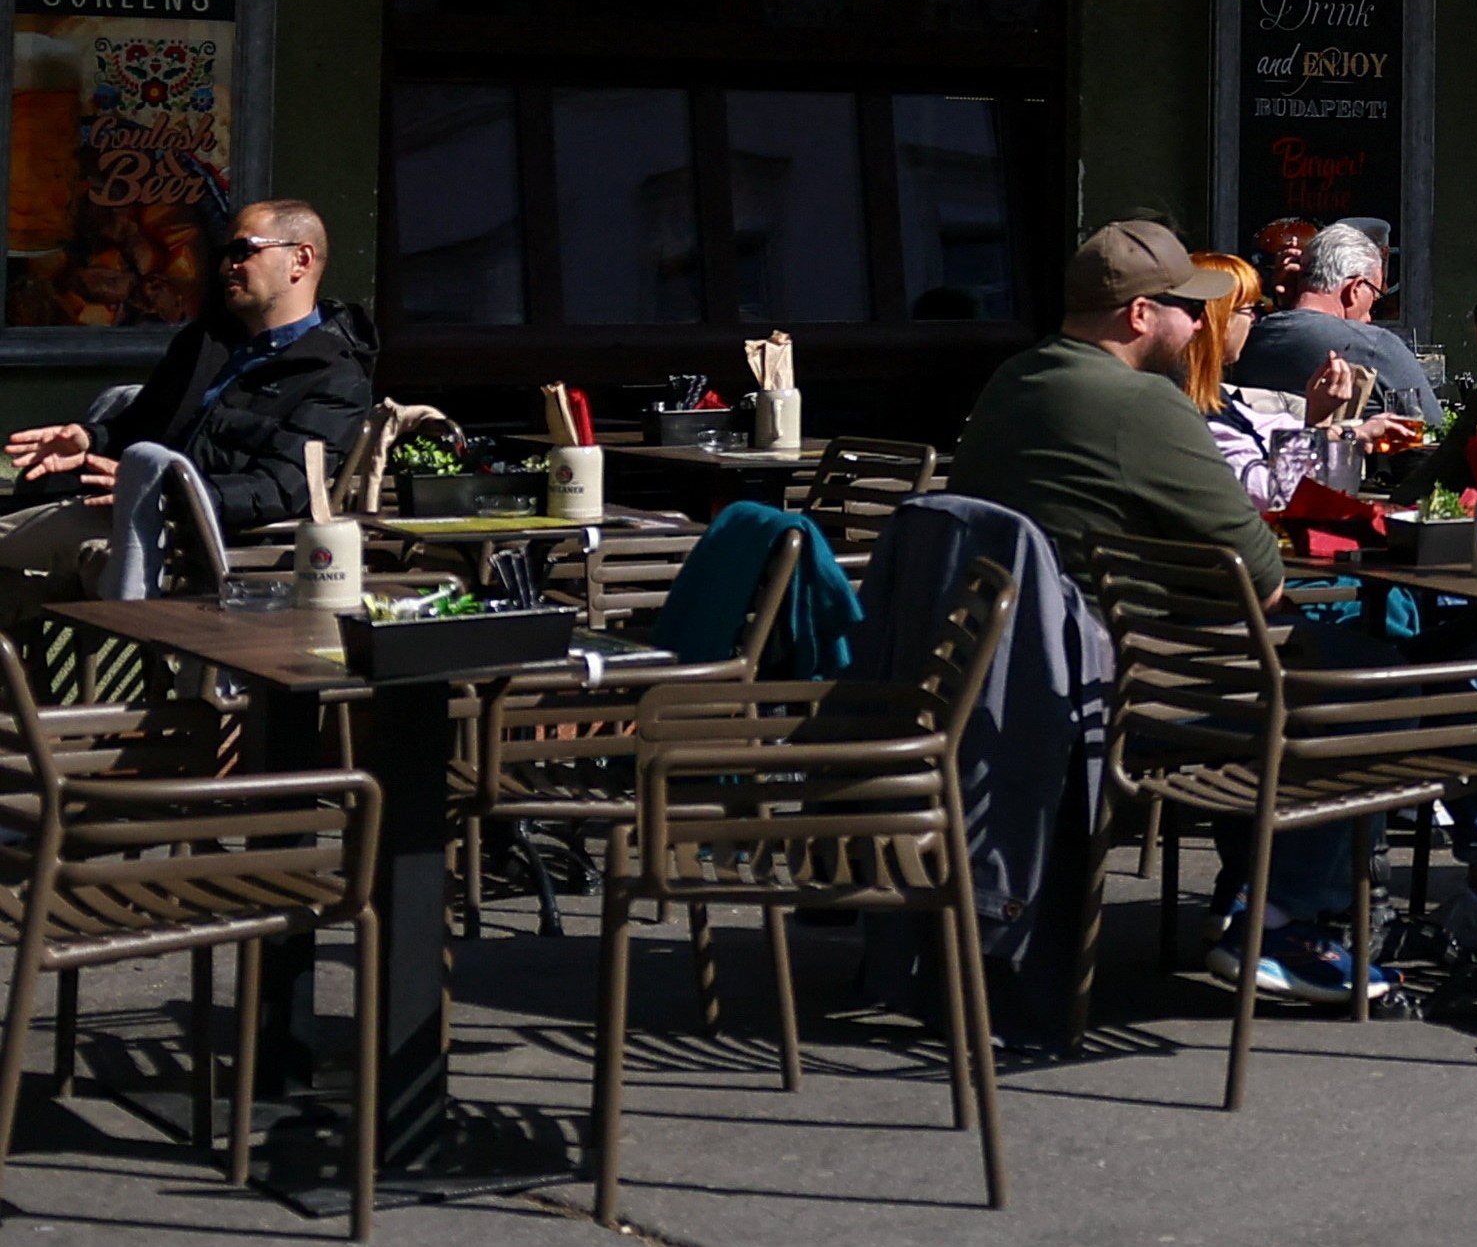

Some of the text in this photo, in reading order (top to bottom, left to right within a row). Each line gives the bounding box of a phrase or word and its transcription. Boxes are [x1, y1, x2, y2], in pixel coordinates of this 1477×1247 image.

[1256, 43, 1389, 86] and ENJOY
[1254, 98, 1388, 119] BUDAPEST!
[88, 112, 218, 153] Goulash
[88, 149, 211, 209] Beer
